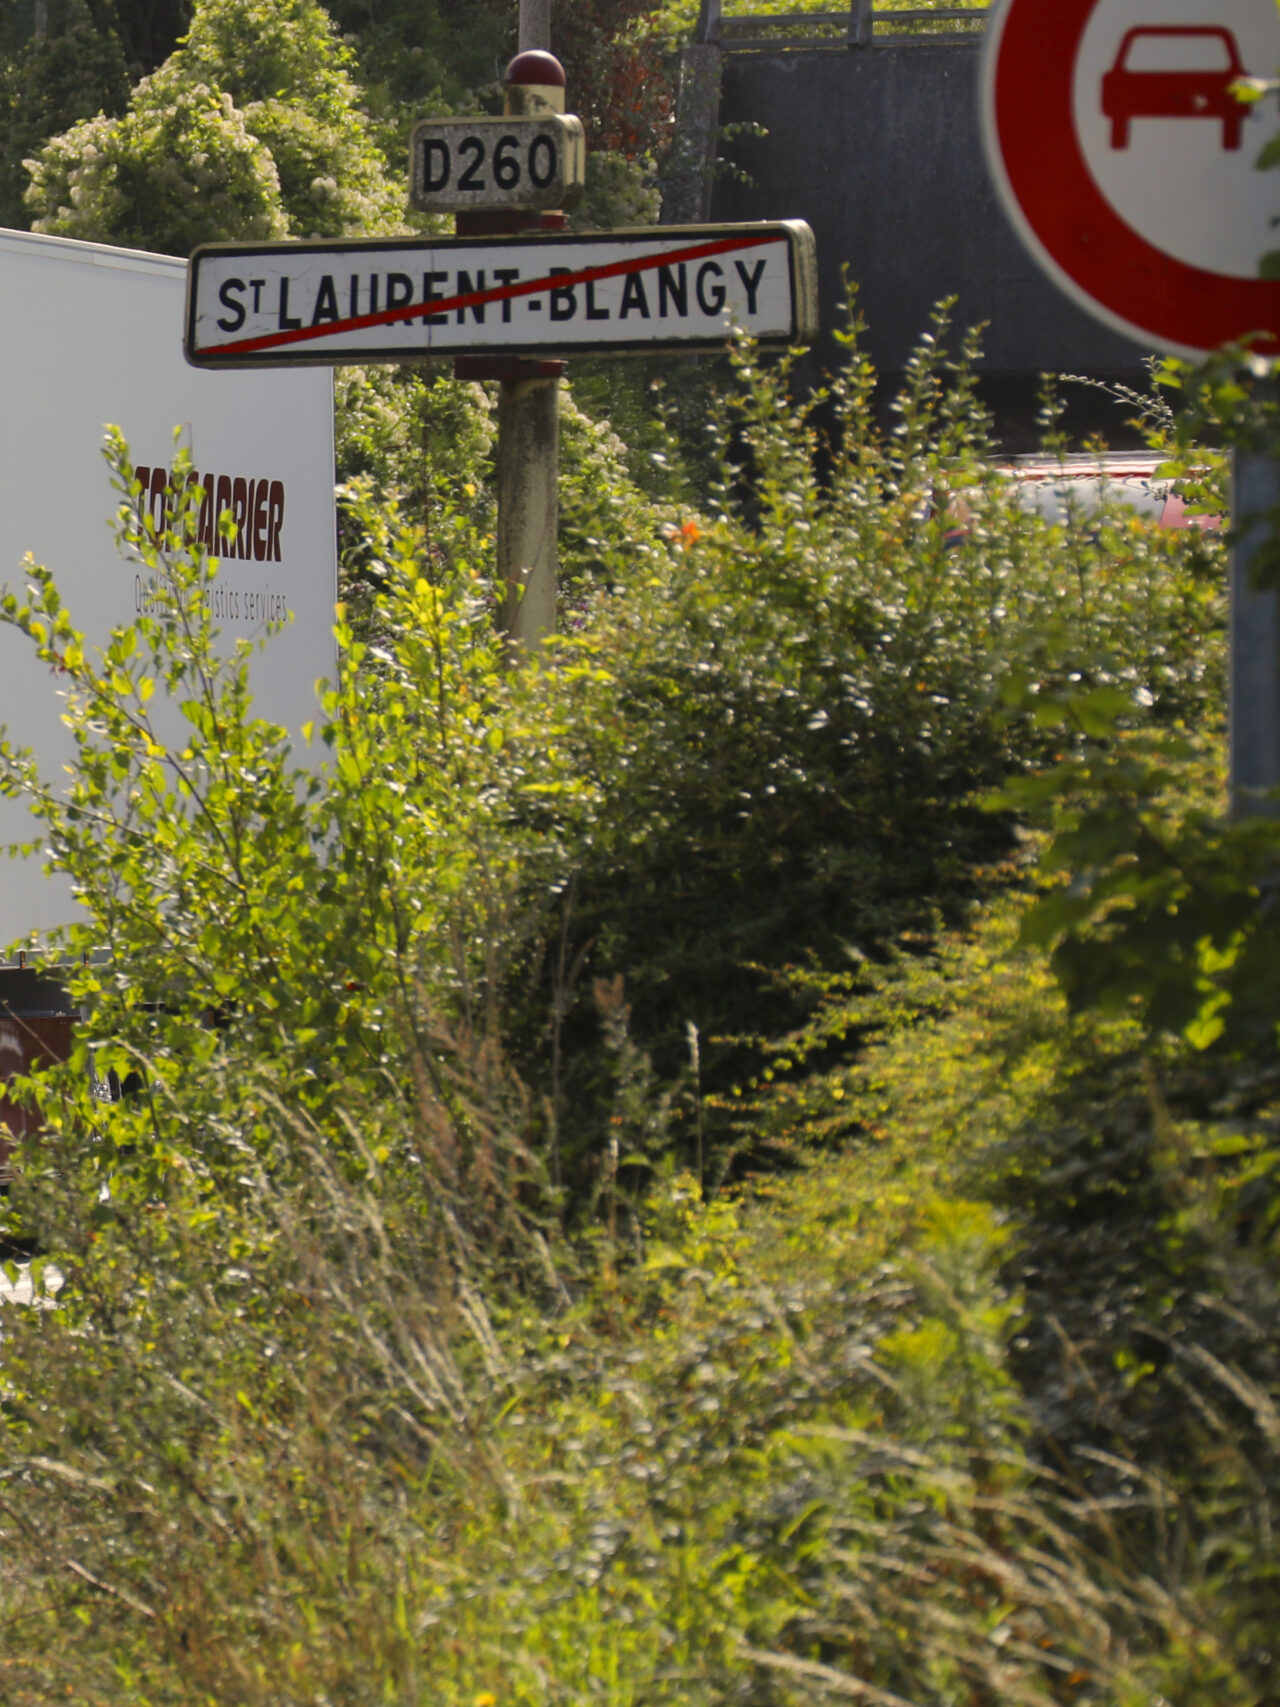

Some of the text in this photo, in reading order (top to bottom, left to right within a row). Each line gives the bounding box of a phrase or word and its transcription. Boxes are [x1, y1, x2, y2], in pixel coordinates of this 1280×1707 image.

[423, 134, 557, 192] D260
[278, 259, 767, 331] LAURENT-BLANGY
[244, 584, 287, 621] services
